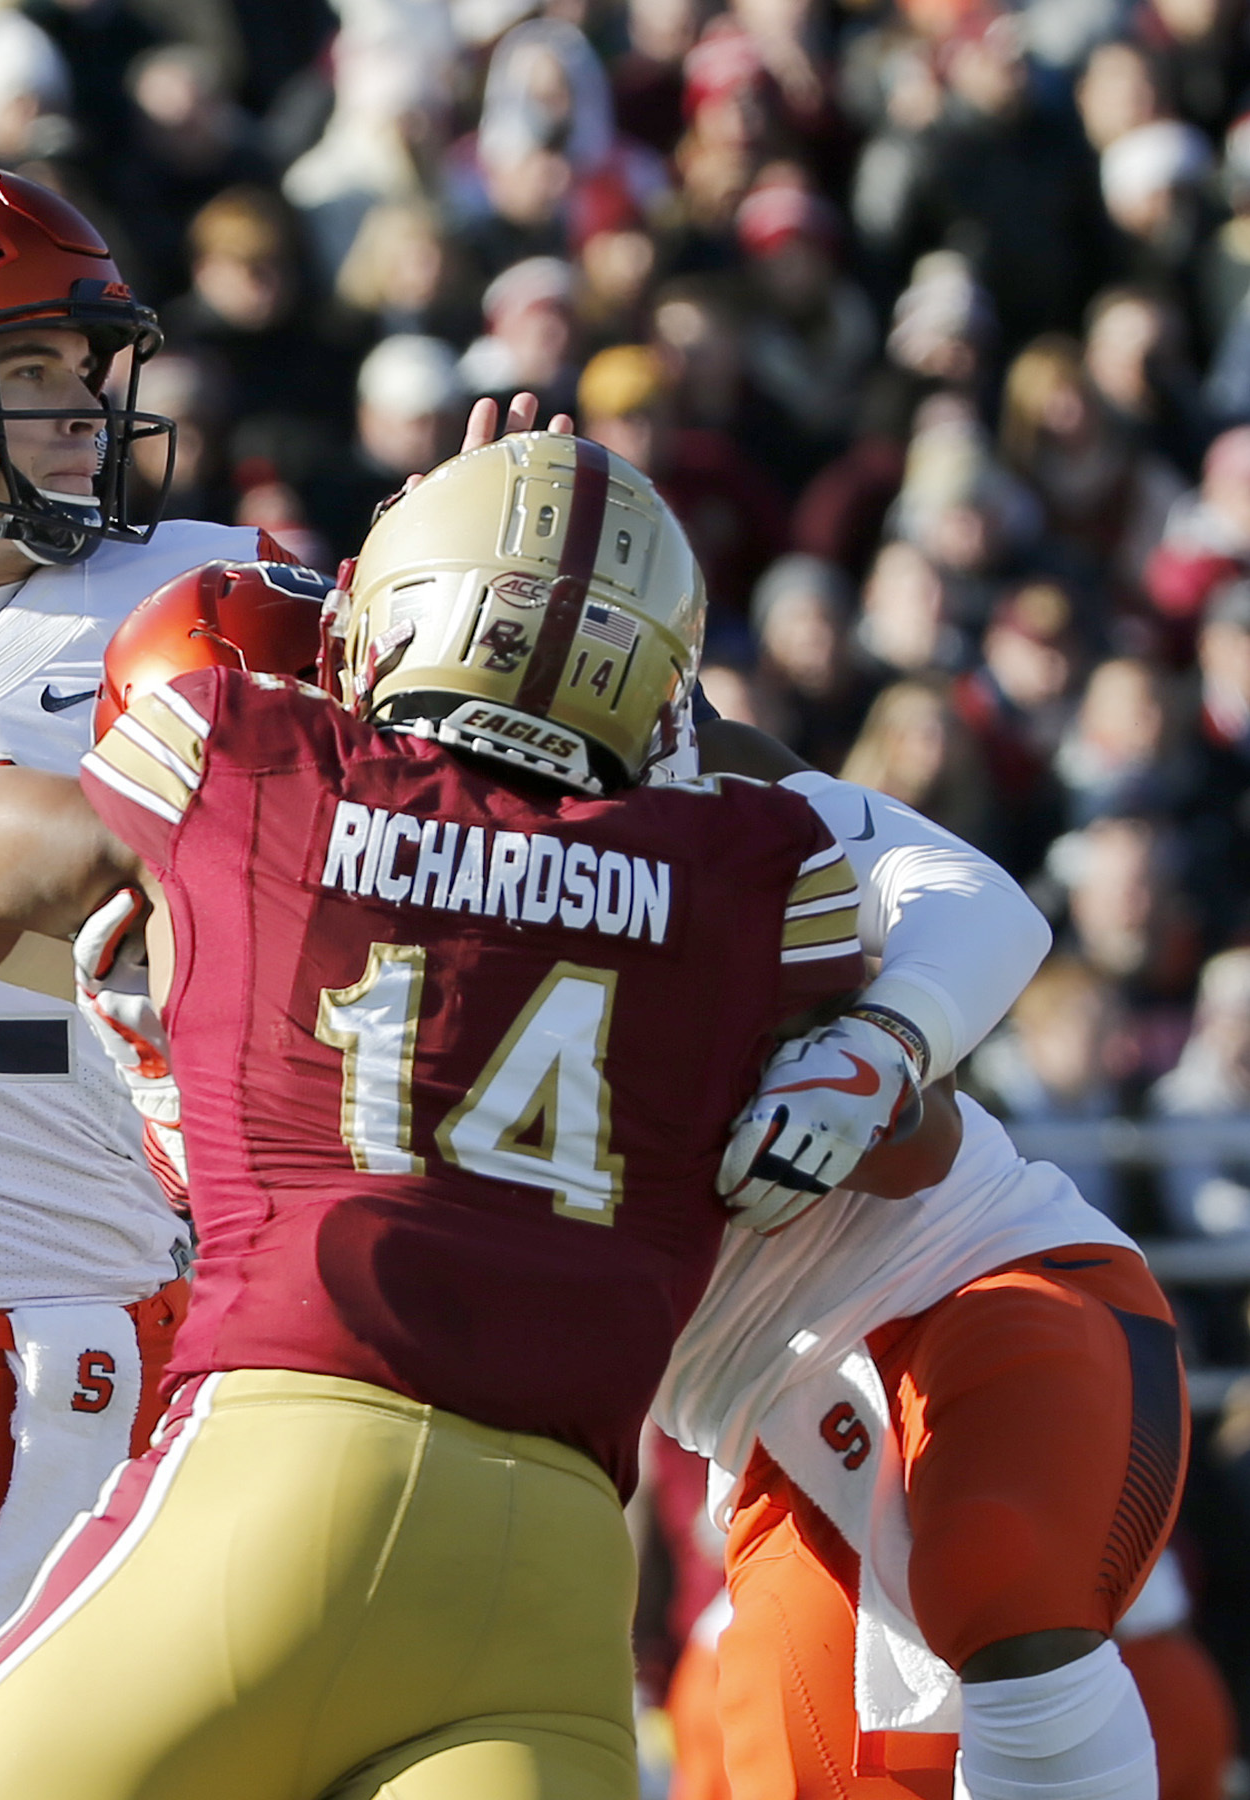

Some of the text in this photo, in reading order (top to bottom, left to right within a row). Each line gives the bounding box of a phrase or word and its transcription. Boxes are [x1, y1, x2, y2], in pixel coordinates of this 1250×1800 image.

[500, 579, 545, 599] ACC
[568, 649, 616, 698] 14
[462, 708, 581, 760] EAGLES
[321, 800, 671, 944] RICHARDSON
[314, 941, 625, 1227] 14
[71, 1348, 116, 1414] S
[819, 1402, 872, 1471] S
